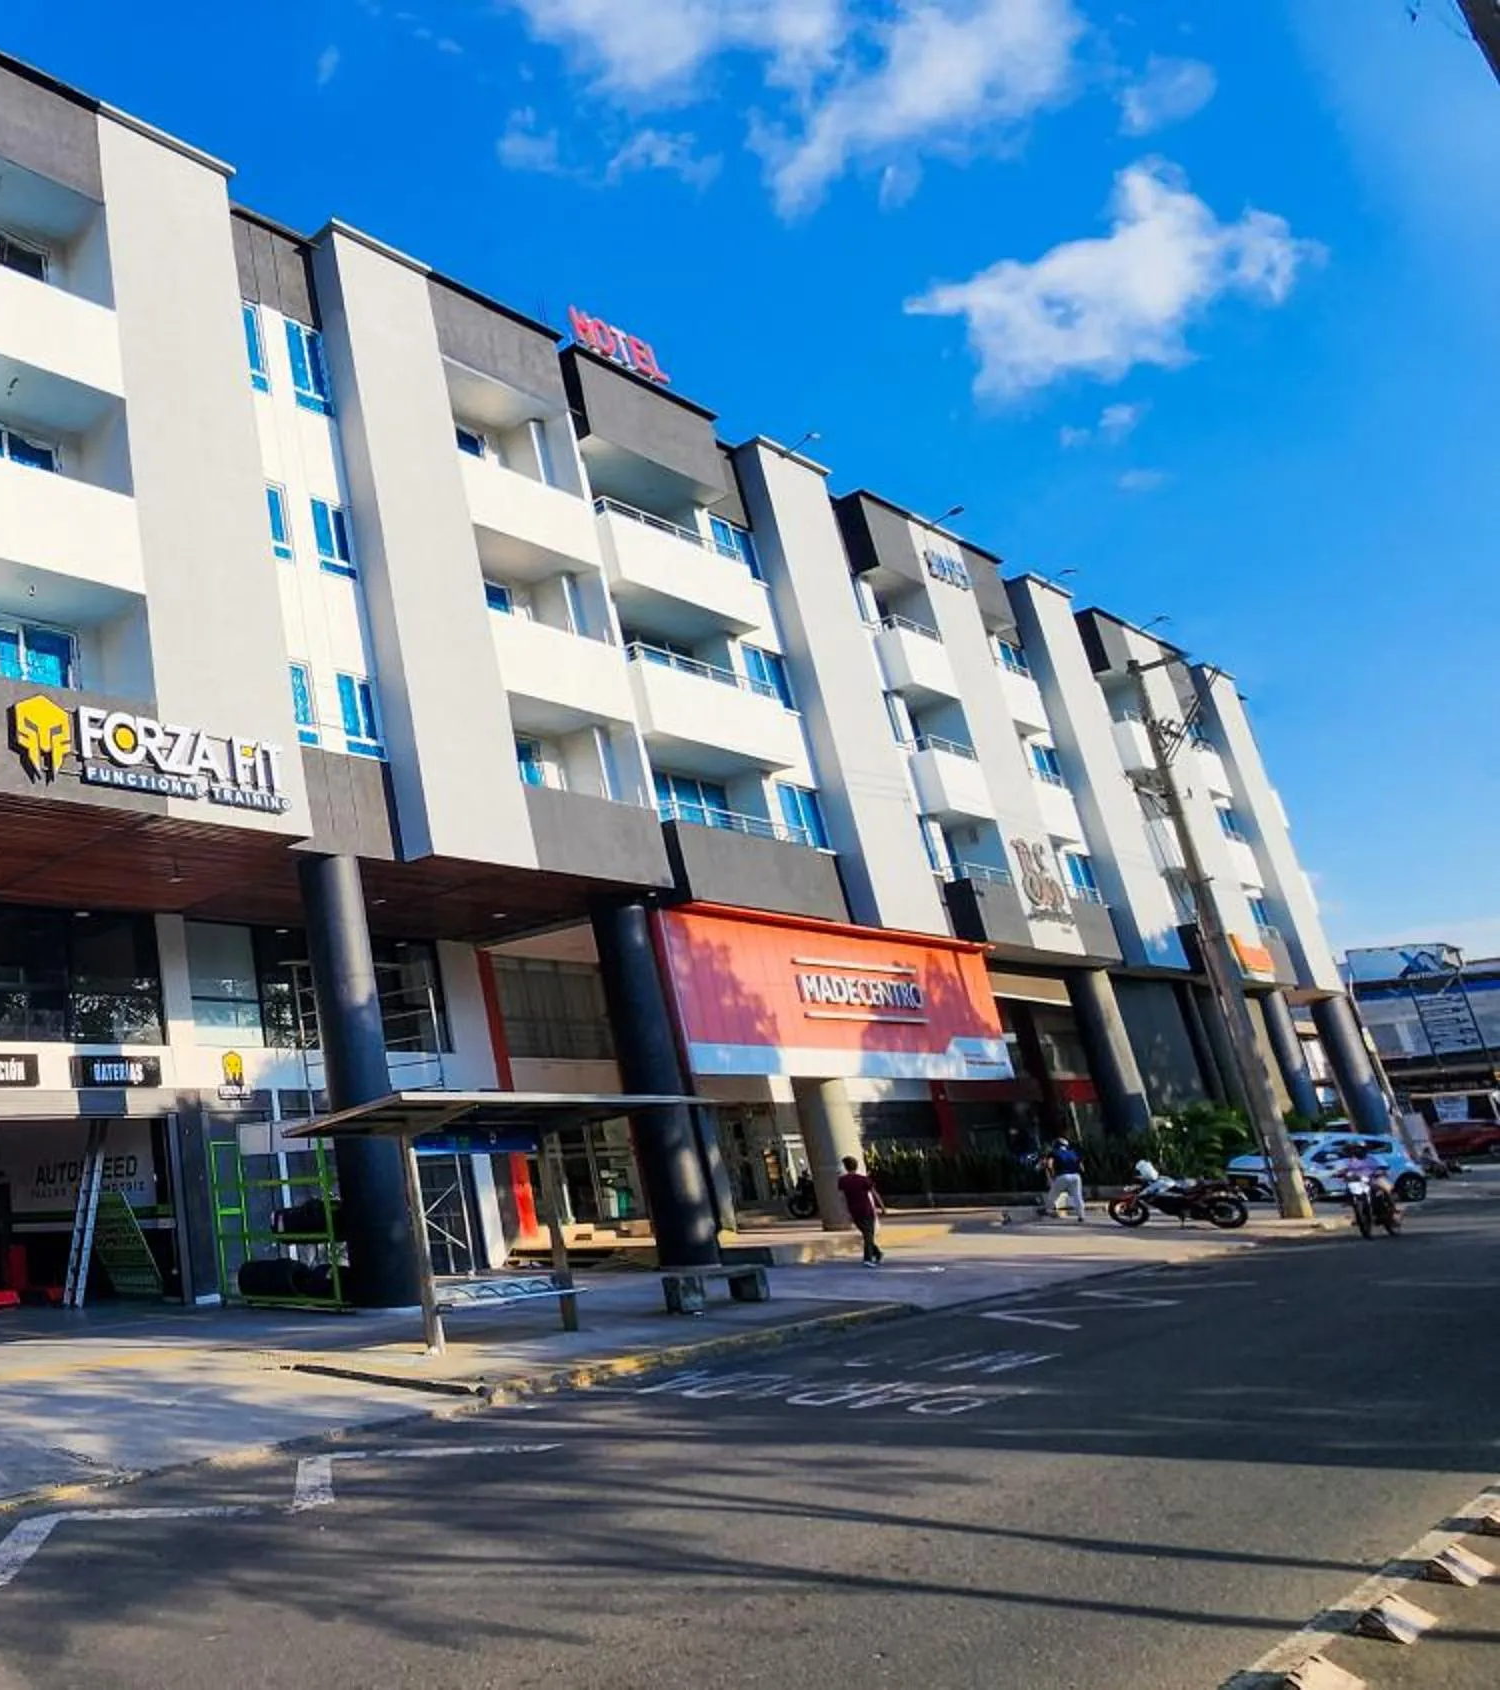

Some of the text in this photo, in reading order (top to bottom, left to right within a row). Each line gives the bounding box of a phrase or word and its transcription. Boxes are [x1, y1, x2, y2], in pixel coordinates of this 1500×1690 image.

[568, 304, 671, 384] HOTEL
[79, 706, 285, 793] FORZA FIT
[213, 787, 293, 811] TRAINING
[797, 973, 925, 1010] MADECENTRO
[35, 1155, 138, 1187] AUTOEED
